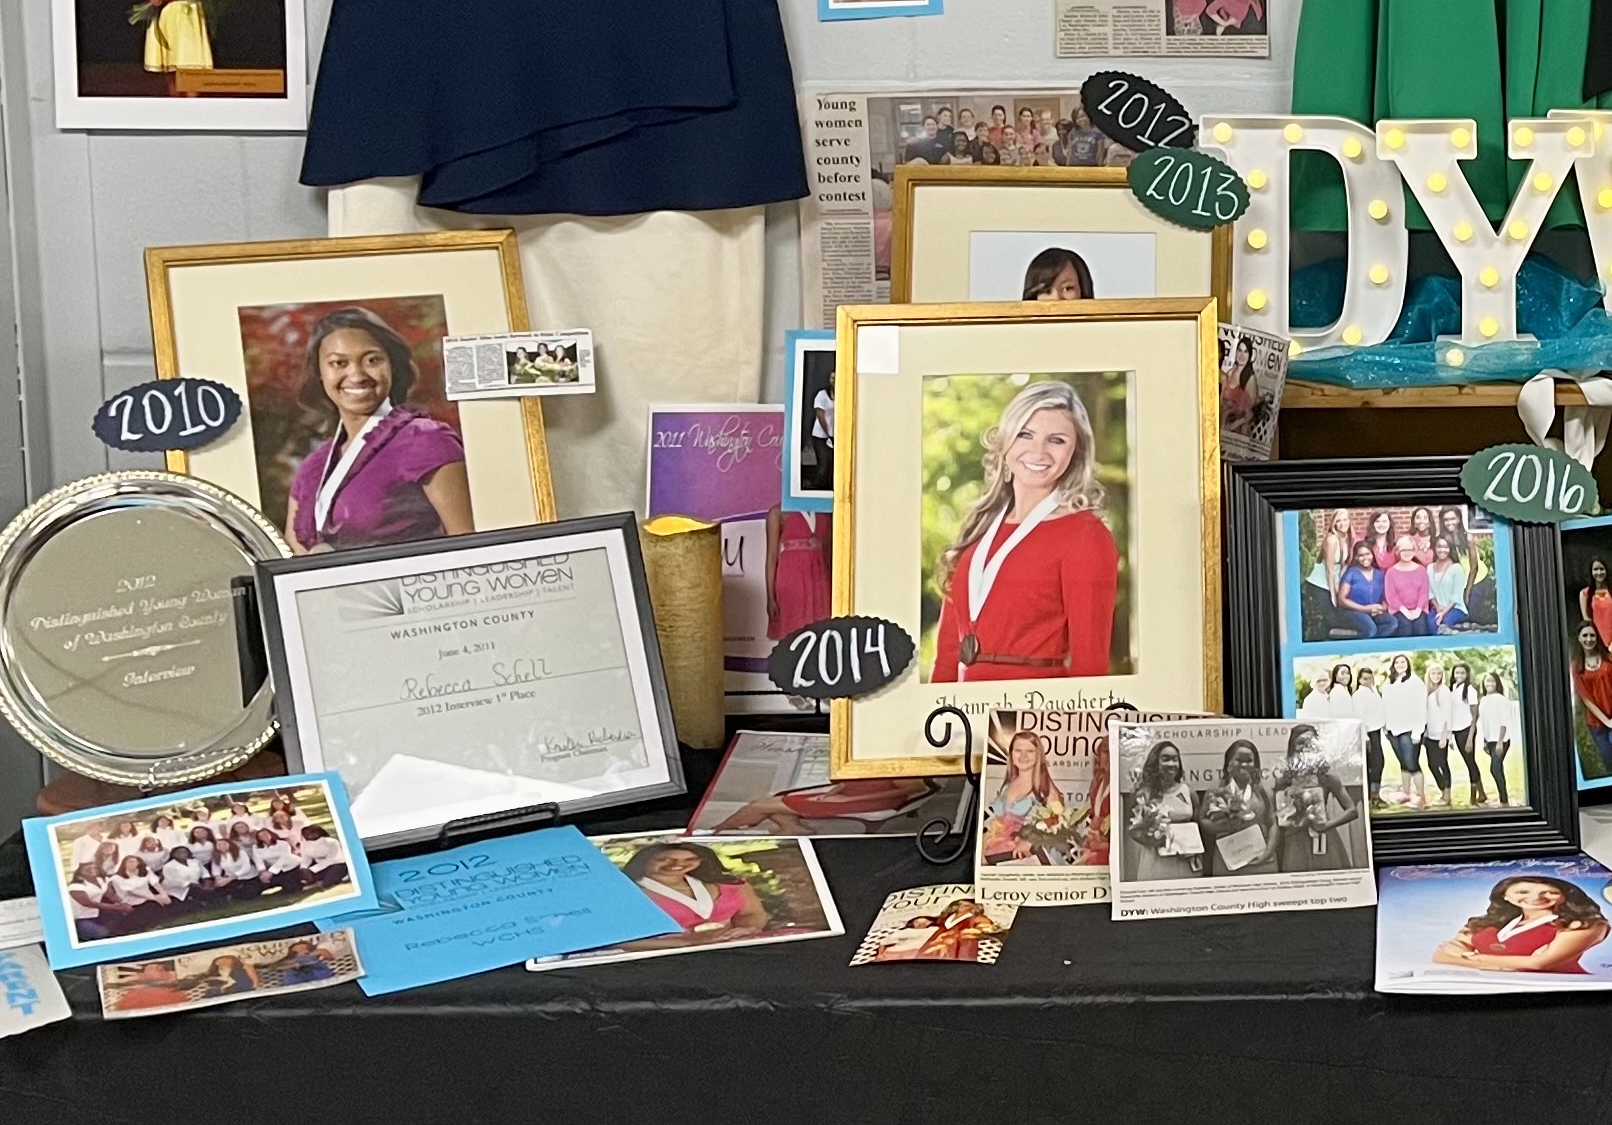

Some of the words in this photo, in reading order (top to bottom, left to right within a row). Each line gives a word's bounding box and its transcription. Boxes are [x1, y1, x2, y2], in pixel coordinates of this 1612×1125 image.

[816, 98, 857, 113] Young
[1098, 80, 1192, 149] 2012
[814, 118, 863, 129] women
[814, 136, 851, 147] serve
[816, 154, 862, 168] county
[817, 171, 861, 183] before
[1145, 155, 1240, 220] 2013
[818, 190, 867, 202] contest
[109, 380, 226, 443] 2010
[653, 431, 686, 448] 2011
[1487, 452, 1584, 514] 2016
[116, 575, 156, 593] 2012
[31, 601, 134, 631] Distinguished
[139, 596, 188, 615] Young
[390, 619, 478, 640] WASHINGTON
[483, 610, 535, 626] COUNTY
[64, 634, 81, 651] of
[85, 620, 173, 645] Washington
[179, 611, 228, 629] County
[438, 649, 459, 660] June
[791, 626, 890, 688] 2014
[122, 665, 195, 687] Interview
[401, 673, 477, 701] Rebecca
[417, 703, 443, 716] 2012
[445, 696, 492, 712] Interview
[509, 690, 536, 702] Place
[1154, 728, 1243, 740] SCHOLARSHIP
[395, 855, 581, 898] DISTINGUISHED
[398, 854, 496, 883] 2012
[393, 901, 491, 925] WASHINGTON
[496, 887, 553, 903] COUNTY
[981, 887, 1031, 905] Leroy
[1035, 889, 1088, 901] senior
[1151, 906, 1208, 916] Washington
[1210, 903, 1246, 913] County
[1247, 899, 1271, 909] High
[1310, 897, 1328, 906] top
[1328, 896, 1348, 904] two
[405, 921, 517, 951] Rebecca
[472, 927, 545, 947] WCHS
